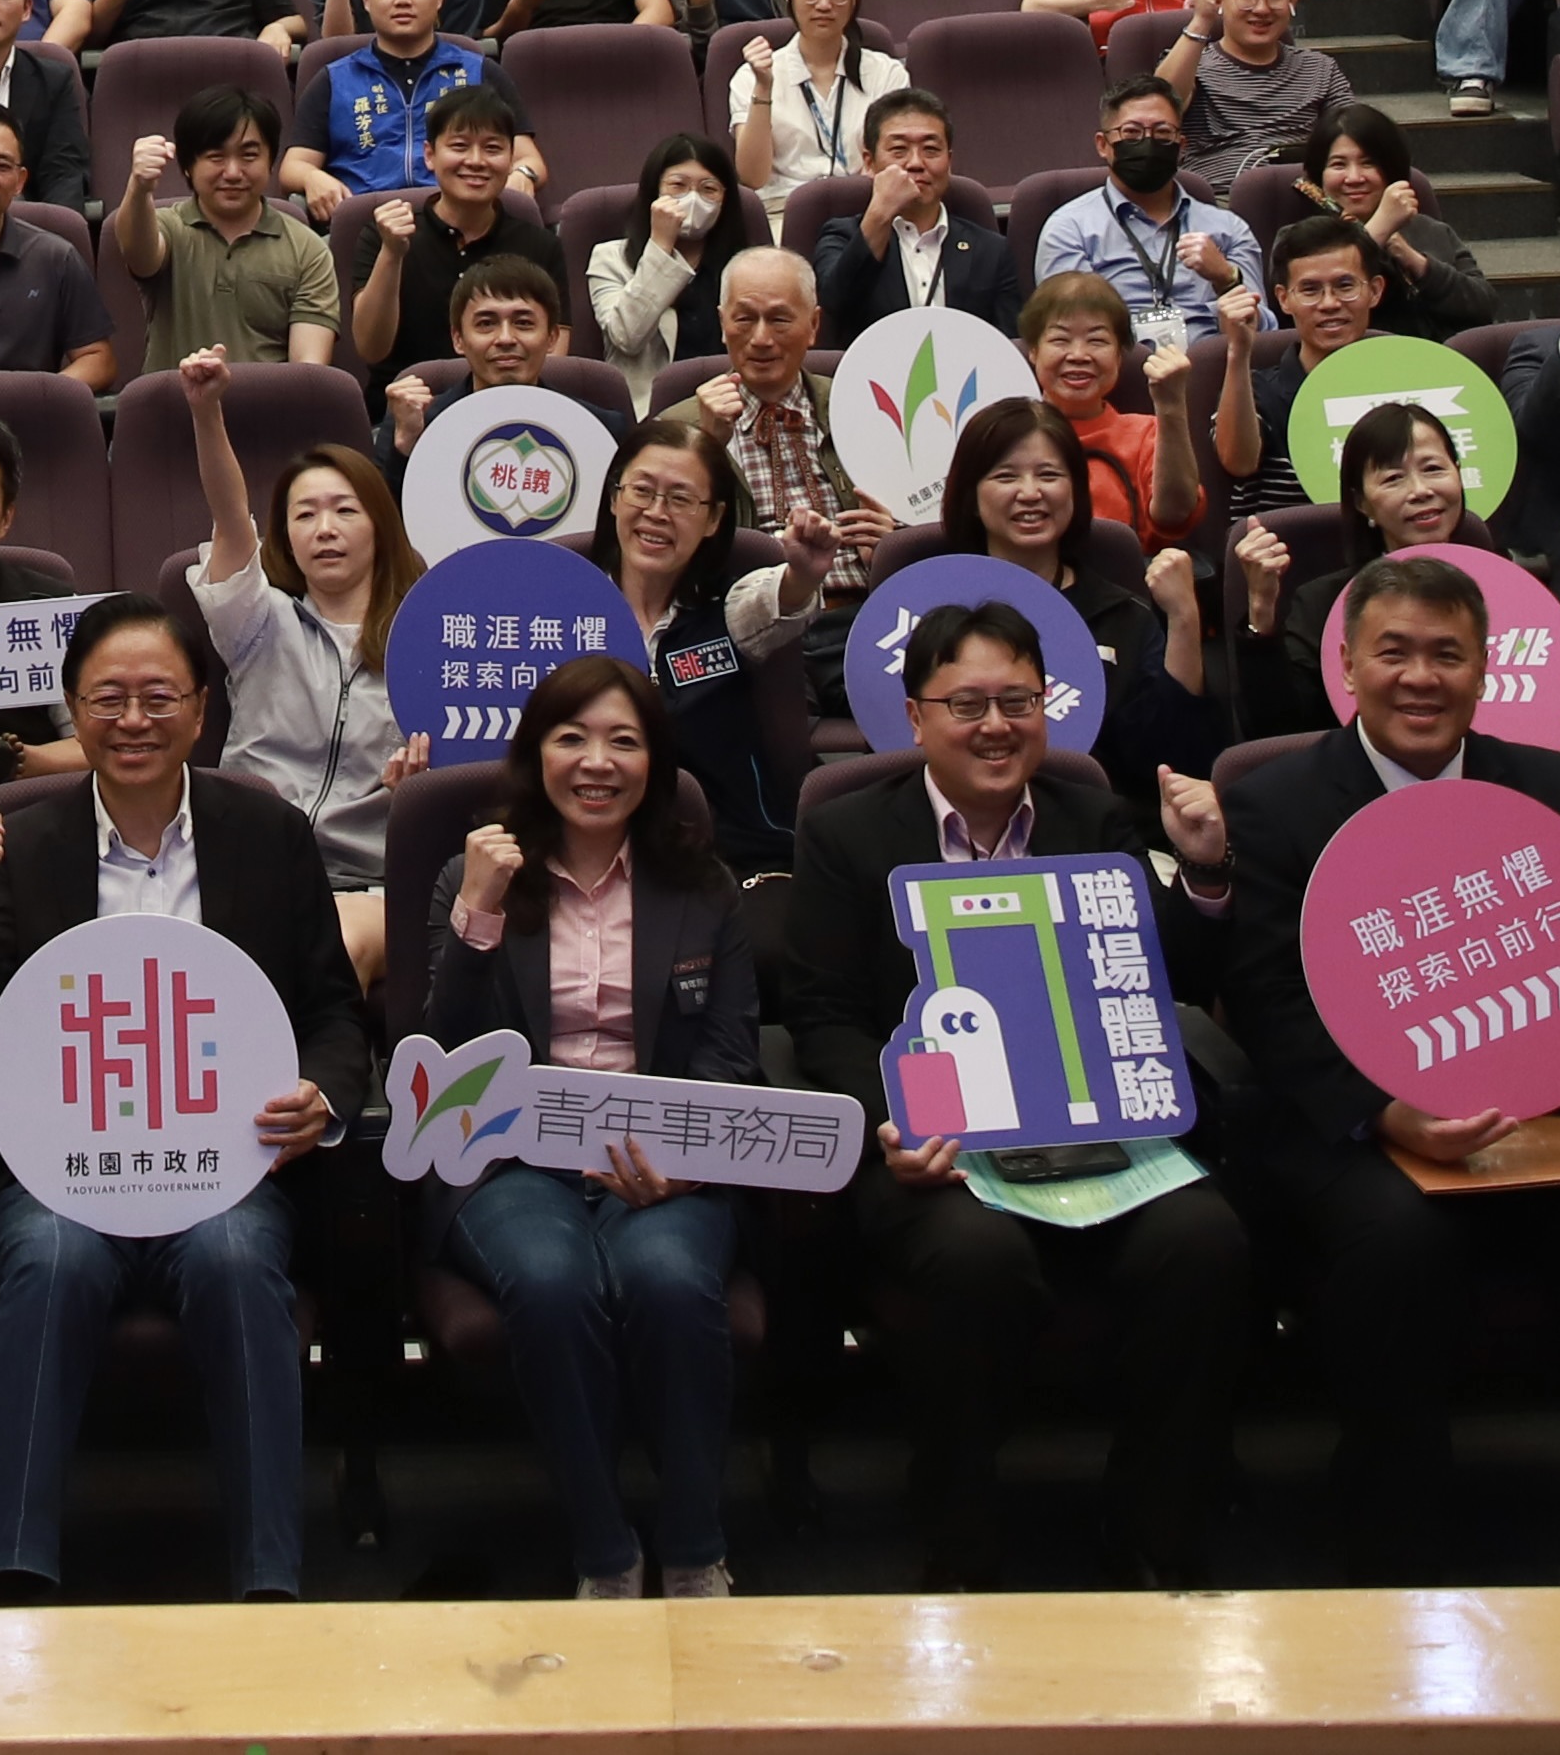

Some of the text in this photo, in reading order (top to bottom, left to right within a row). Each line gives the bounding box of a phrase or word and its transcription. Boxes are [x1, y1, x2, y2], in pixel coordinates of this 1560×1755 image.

[371, 84, 389, 115] 副主任
[353, 97, 376, 150] 羅芳奕
[490, 461, 552, 495] 桃議
[441, 612, 608, 653] 職涯無懼
[1349, 843, 1554, 961] 職涯無懼
[1069, 869, 1183, 1123] 職場體驗
[532, 1086, 842, 1169] 青年事務局
[64, 1147, 221, 1179] 桃園市政府
[64, 1180, 222, 1196] TAOYUAN CITY GOVERNMENT
